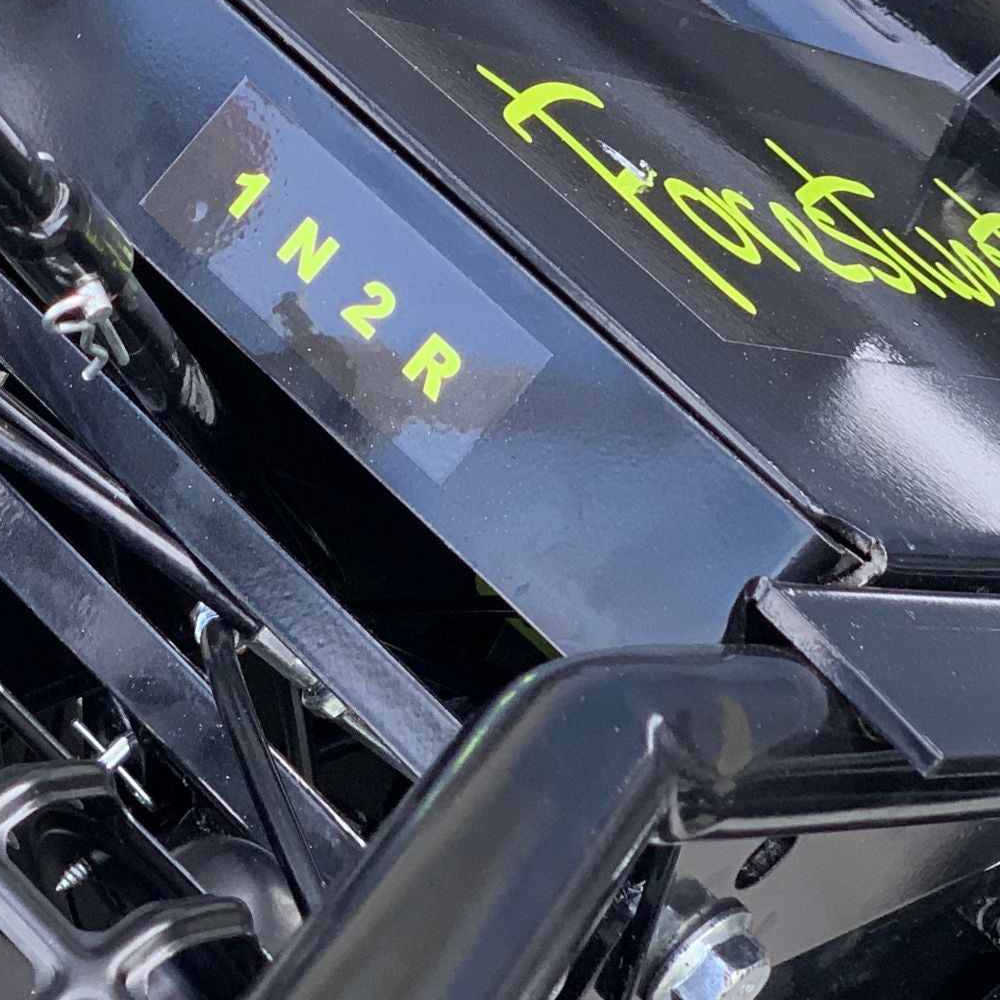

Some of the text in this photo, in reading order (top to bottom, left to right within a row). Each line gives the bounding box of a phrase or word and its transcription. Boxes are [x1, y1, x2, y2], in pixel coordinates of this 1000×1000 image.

[228, 173, 462, 402] 1 N 2 R
